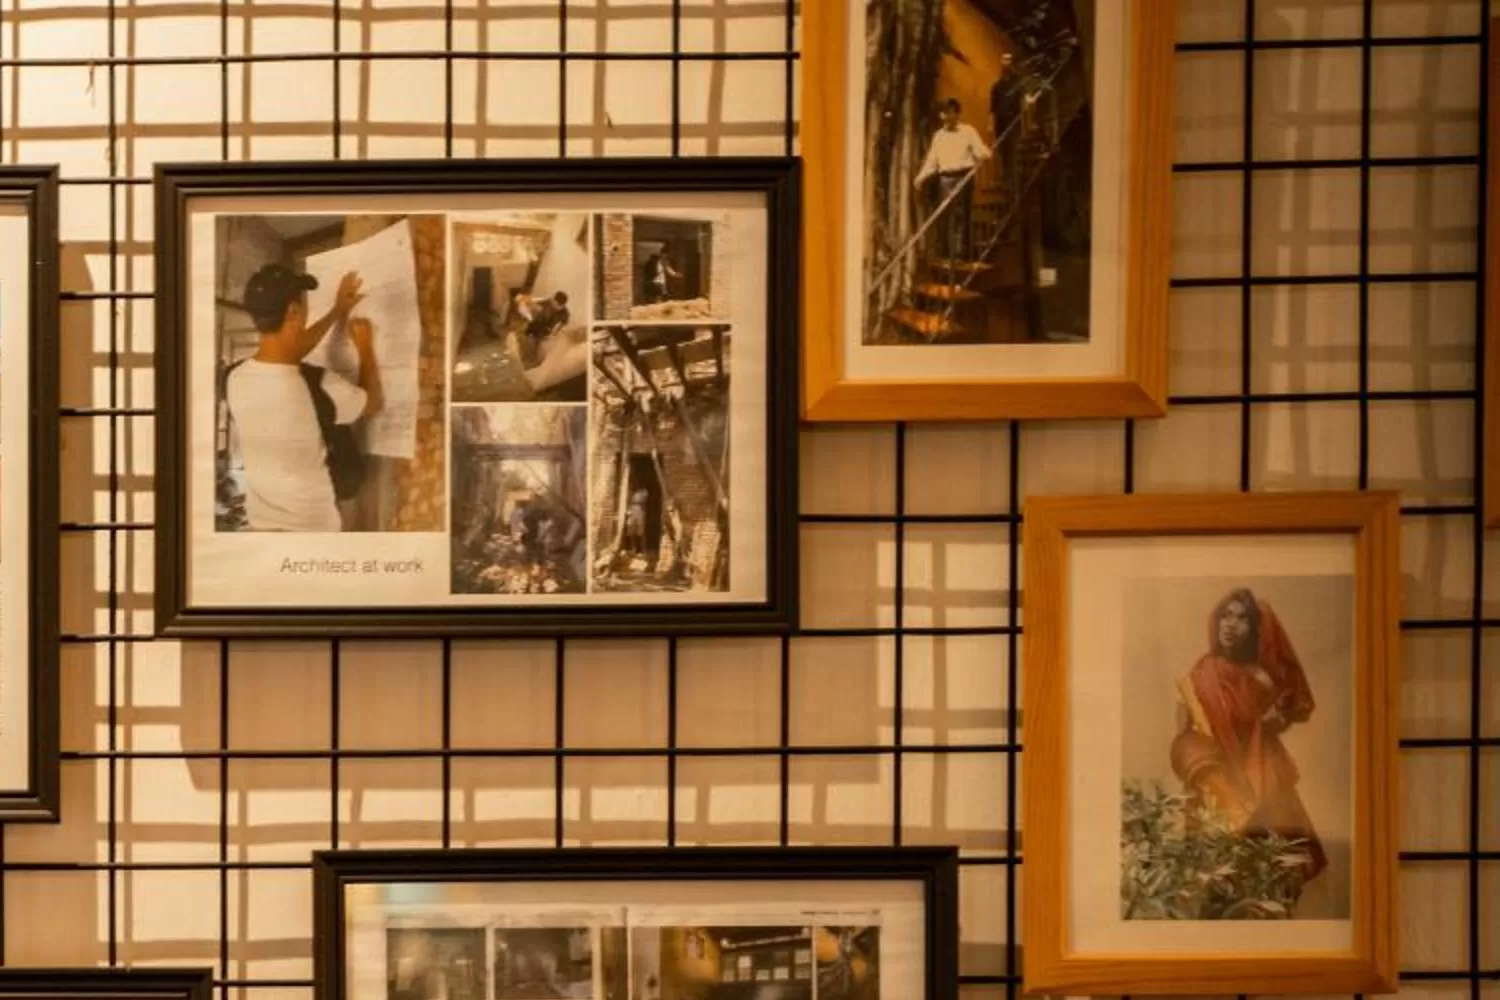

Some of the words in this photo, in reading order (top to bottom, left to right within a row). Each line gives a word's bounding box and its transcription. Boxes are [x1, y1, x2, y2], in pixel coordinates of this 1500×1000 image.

[280, 557, 357, 573] Architect
[362, 559, 377, 573] at
[384, 557, 423, 573] work
